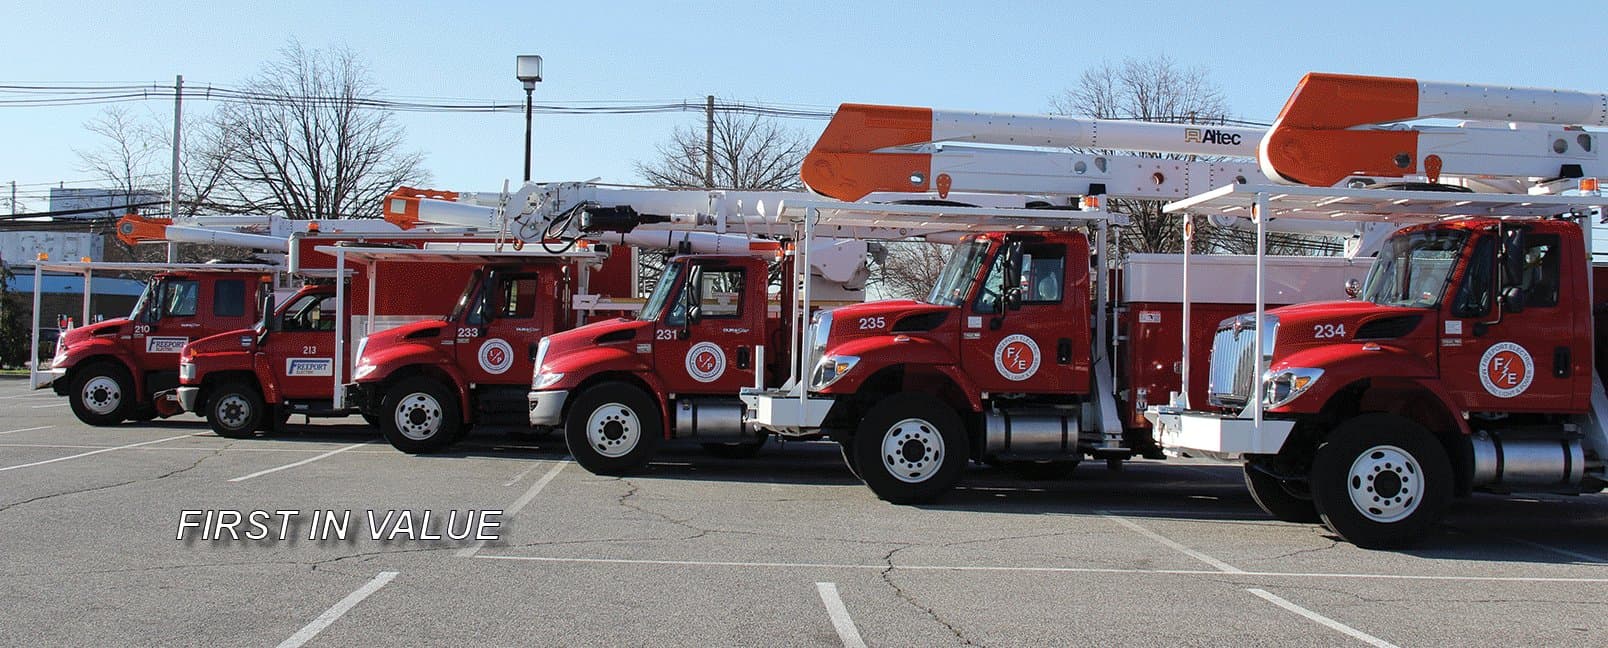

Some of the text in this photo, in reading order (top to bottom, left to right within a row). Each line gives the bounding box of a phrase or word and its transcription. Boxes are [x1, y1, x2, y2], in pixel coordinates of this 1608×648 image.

[1202, 129, 1241, 146] Altec
[134, 324, 151, 333] 210
[859, 316, 886, 330] 235
[457, 327, 479, 338] 233
[656, 329, 678, 340] 231
[1313, 323, 1347, 339] 234
[149, 337, 187, 352] FREEPORT
[302, 345, 317, 355] 213
[1007, 347, 1027, 370] F E
[288, 359, 330, 375] FREEPORT
[1494, 357, 1518, 385] F E
